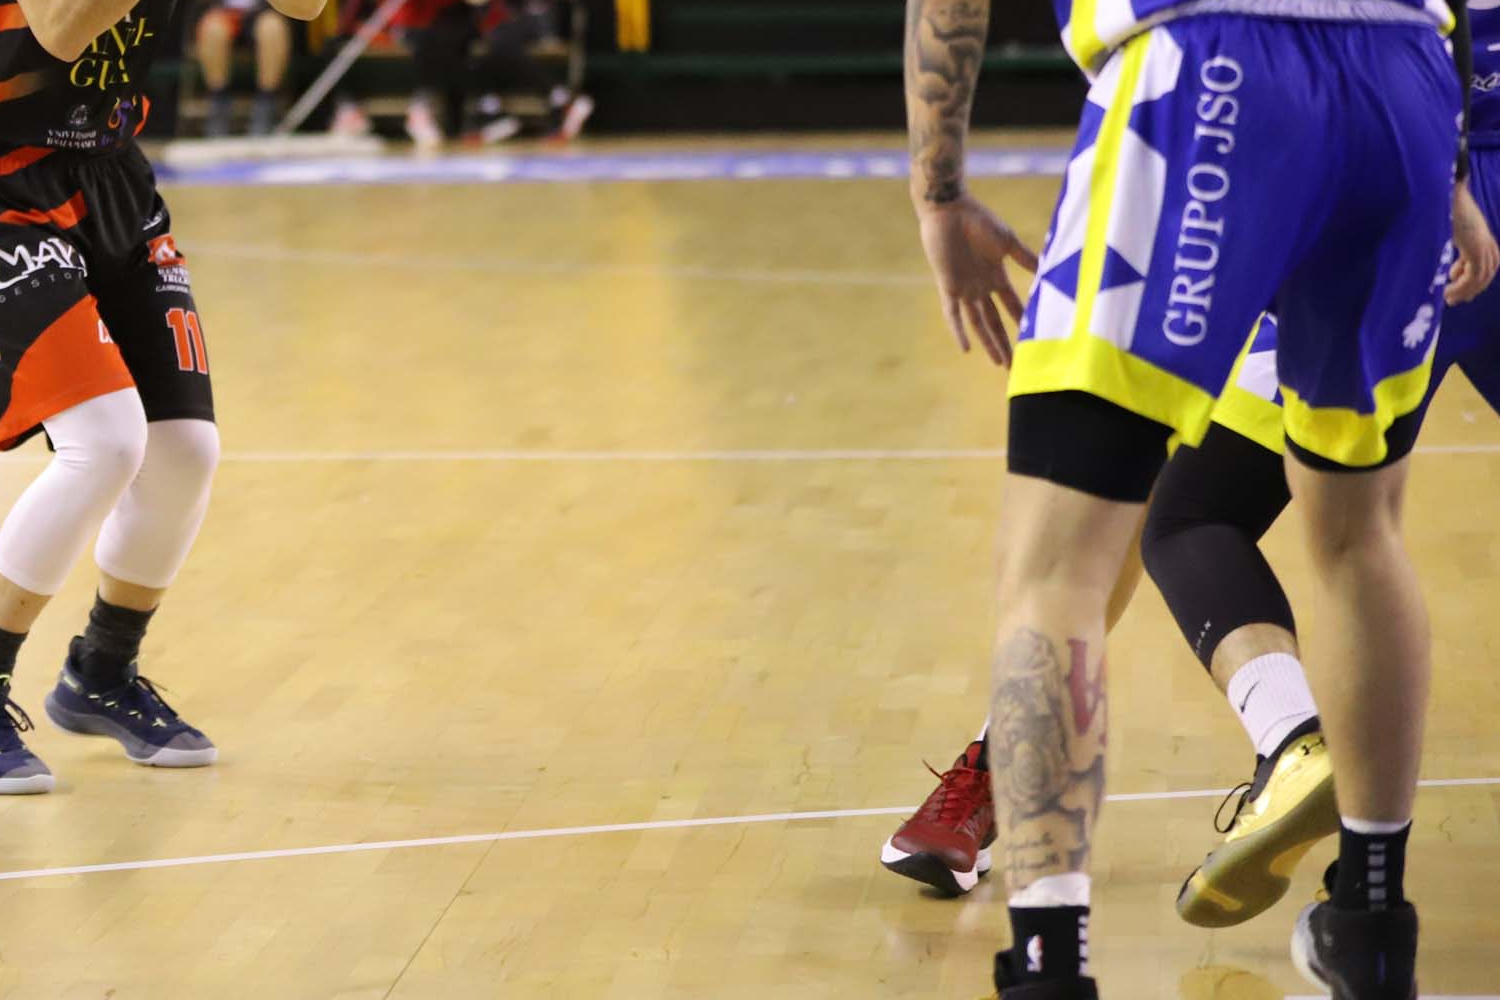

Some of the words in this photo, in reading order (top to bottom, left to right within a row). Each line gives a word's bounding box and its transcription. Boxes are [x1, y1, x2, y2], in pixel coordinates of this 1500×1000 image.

[1193, 55, 1244, 155] JSO
[1162, 163, 1230, 347] GRUPO
[165, 307, 208, 375] 11
